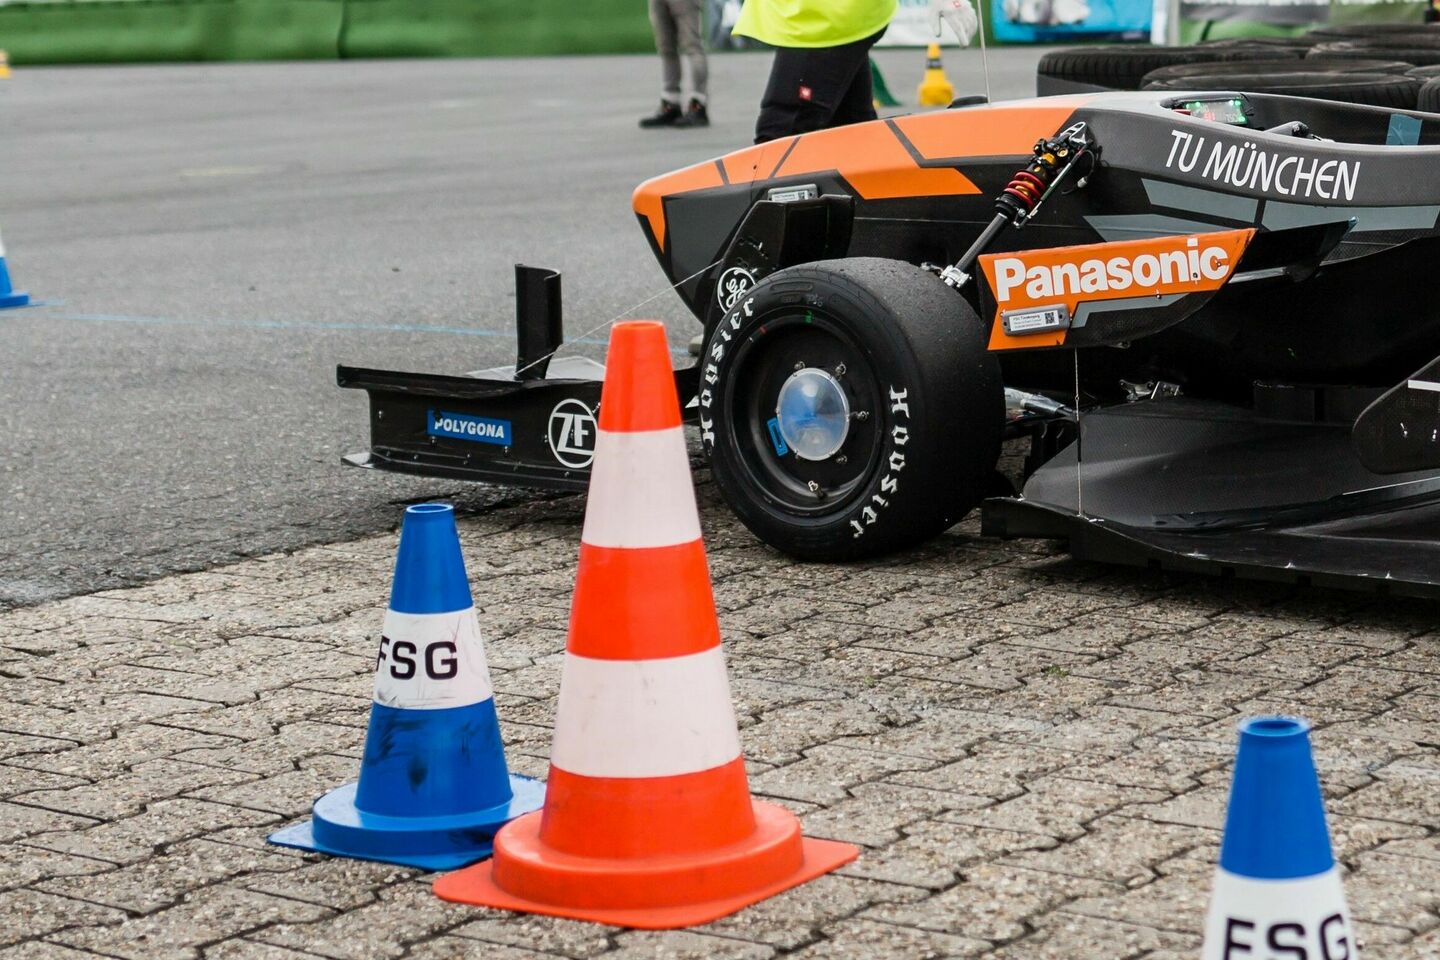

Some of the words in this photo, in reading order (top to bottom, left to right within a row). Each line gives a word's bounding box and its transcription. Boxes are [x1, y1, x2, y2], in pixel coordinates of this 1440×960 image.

[1165, 129, 1205, 173] TU
[1201, 141, 1361, 201] MÜNCHEN
[993, 237, 1230, 302] Panasonic
[700, 297, 754, 450] Hoosier
[434, 418, 505, 439] POLYGONA
[553, 412, 594, 457] ZF
[850, 384, 910, 539] Hoosier
[376, 634, 458, 680] FSG
[1223, 913, 1350, 960] FSG
